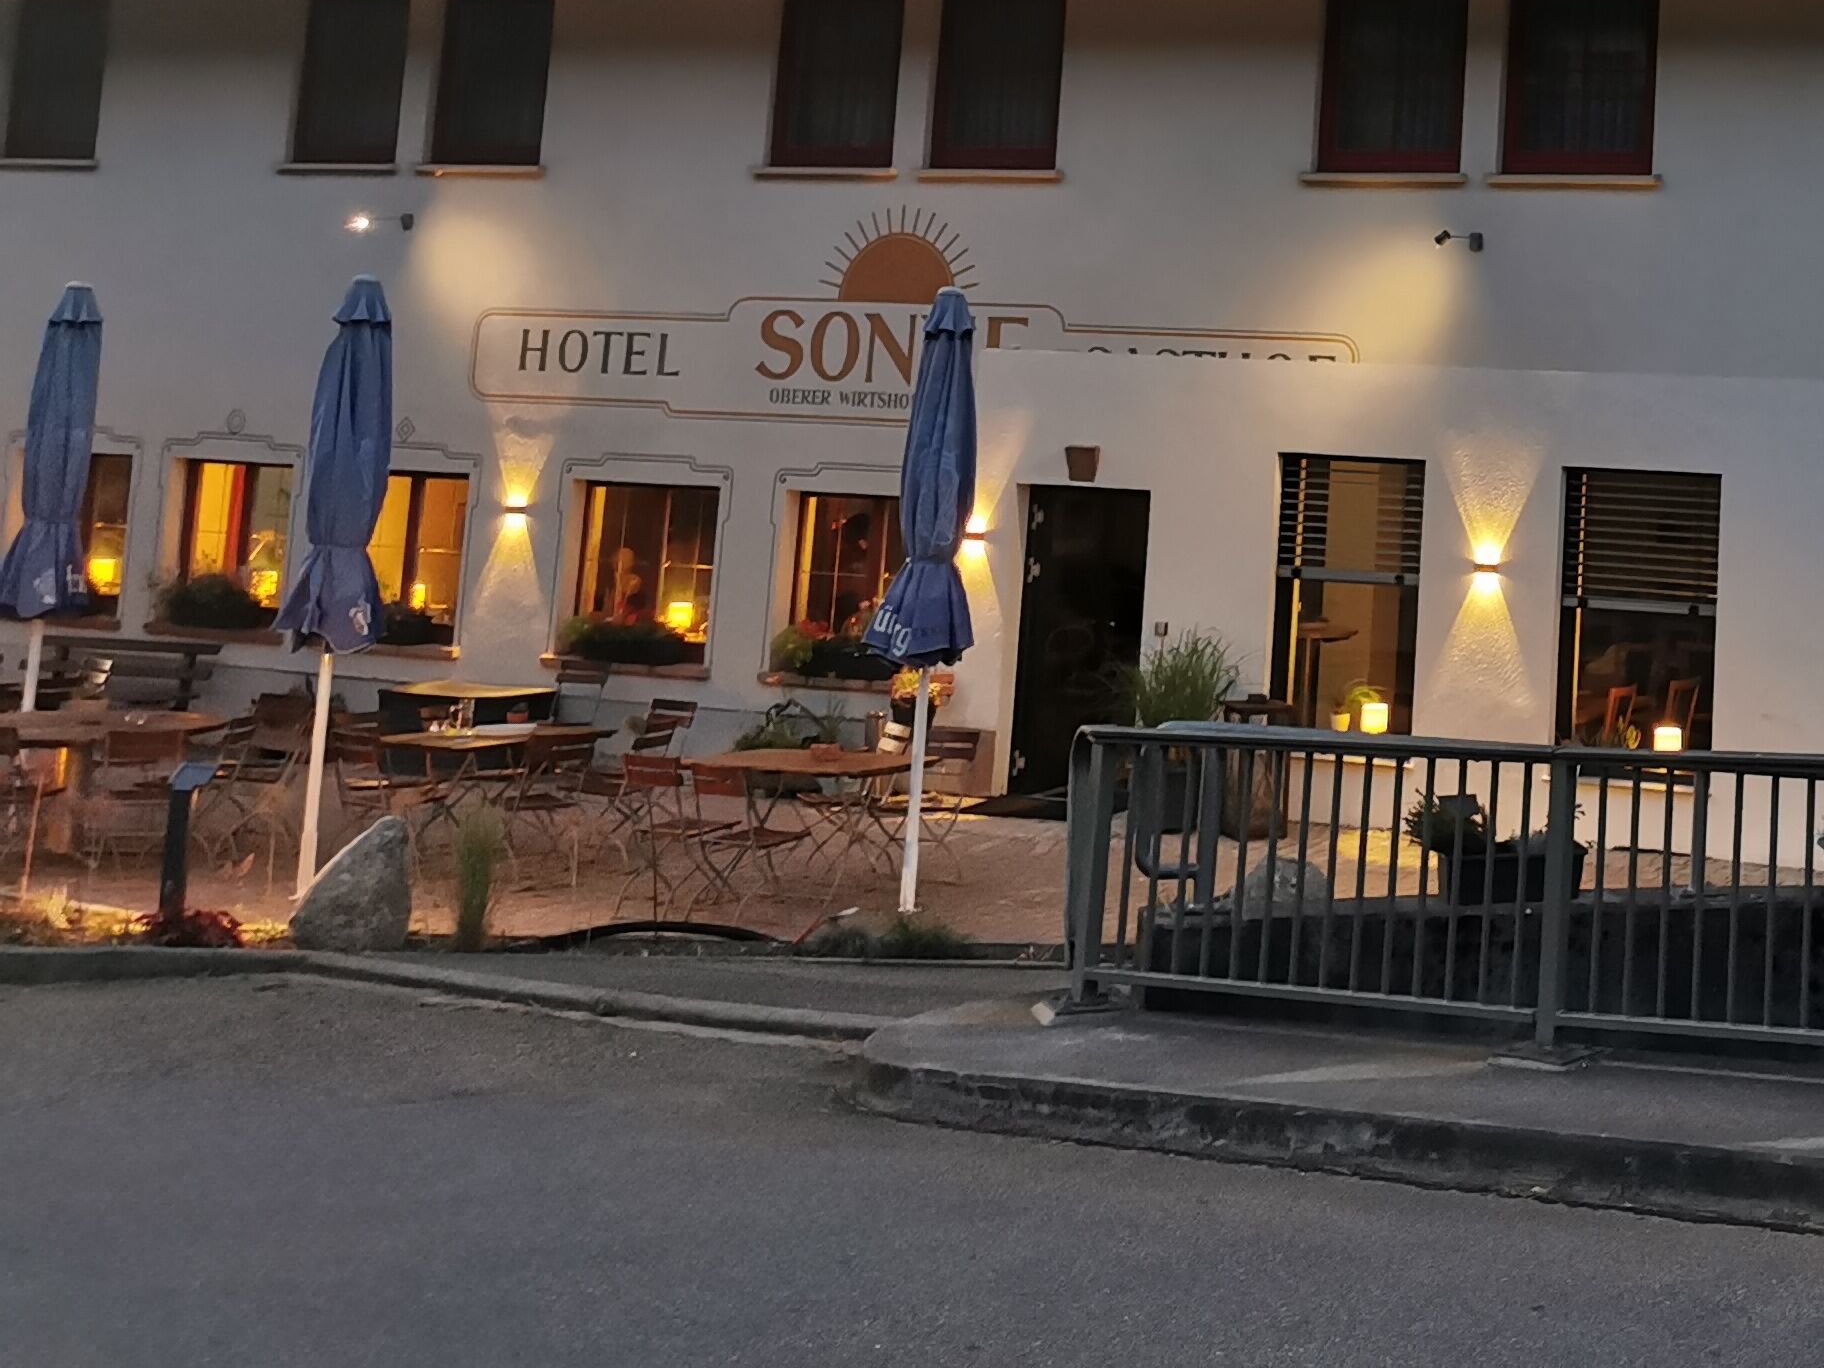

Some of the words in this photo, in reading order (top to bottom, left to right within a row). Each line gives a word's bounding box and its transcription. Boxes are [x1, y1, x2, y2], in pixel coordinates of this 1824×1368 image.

[518, 328, 680, 377] HOTEL
[755, 309, 1029, 386] SON
[769, 387, 832, 406] OBERER
[838, 390, 910, 410] WIRTSHO
